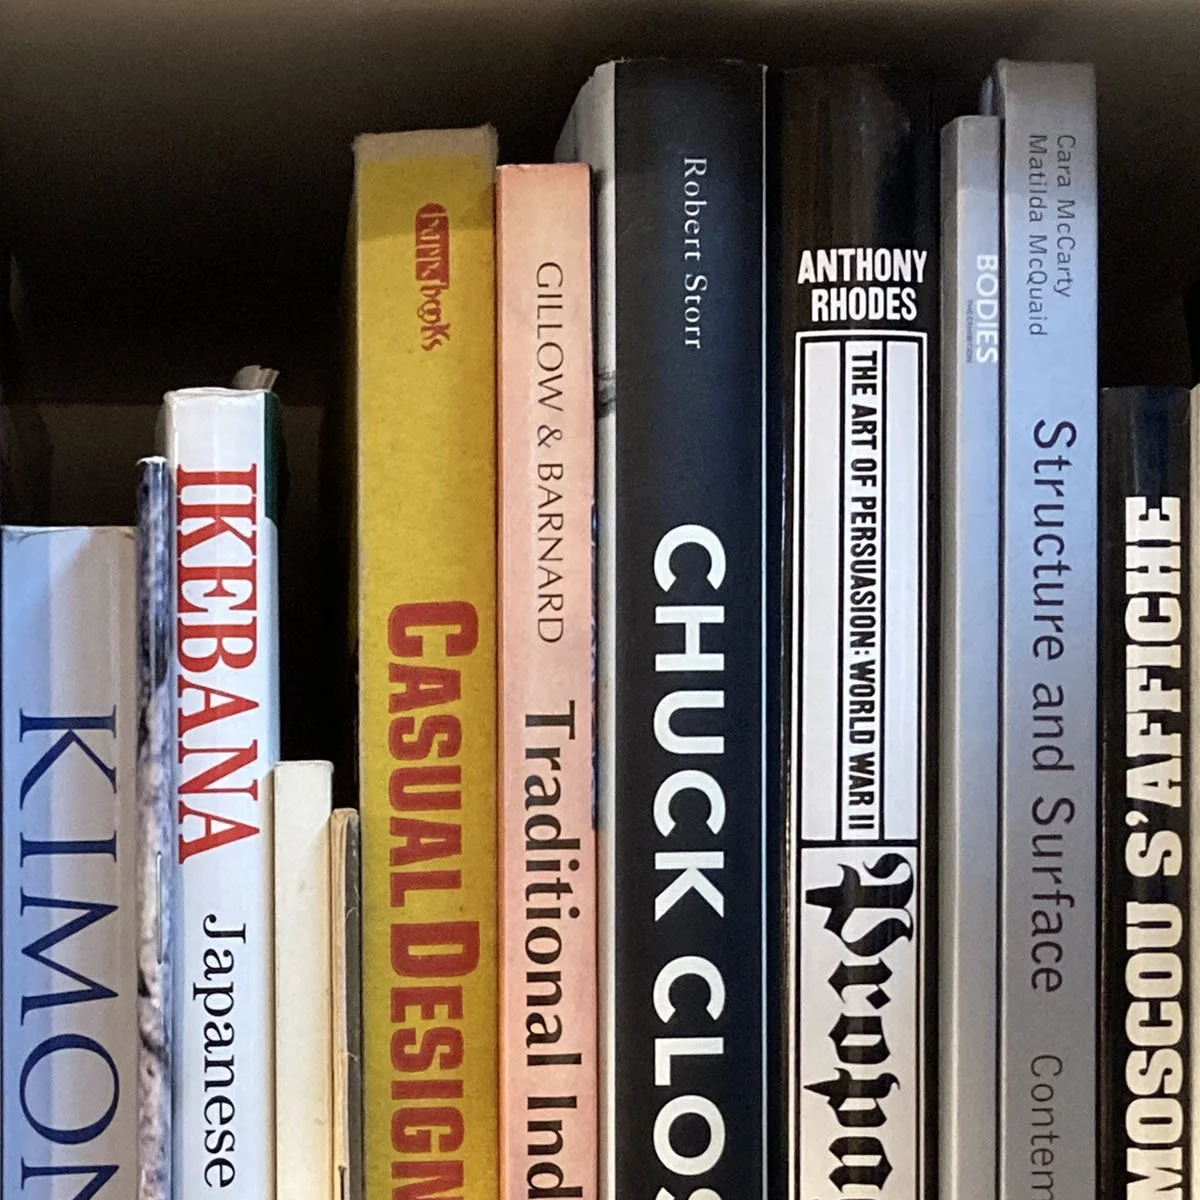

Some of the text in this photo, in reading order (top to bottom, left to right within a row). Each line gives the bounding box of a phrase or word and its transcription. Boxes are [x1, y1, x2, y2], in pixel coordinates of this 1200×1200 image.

[684, 158, 708, 350] Robert Storr
[797, 247, 928, 285] ANTHONY
[1026, 133, 1049, 336] Matilda McQuaid
[1052, 134, 1077, 298] Cara McCarty
[811, 286, 918, 322] RHODES
[851, 350, 878, 396] THE
[976, 253, 999, 364] BODIES
[536, 261, 564, 644] GILLOW & BARNARD
[850, 458, 878, 488] OF
[851, 403, 878, 451] ART
[176, 463, 260, 863] IKEBANA
[653, 524, 727, 922] CHUCK
[848, 659, 876, 745] WORLD
[1030, 419, 1077, 993] Structure and Surface
[387, 600, 479, 908] CASUAL
[848, 751, 875, 806] WAR
[848, 814, 875, 830] II
[524, 699, 582, 1067] Traditional
[192, 913, 247, 1188] Japanese
